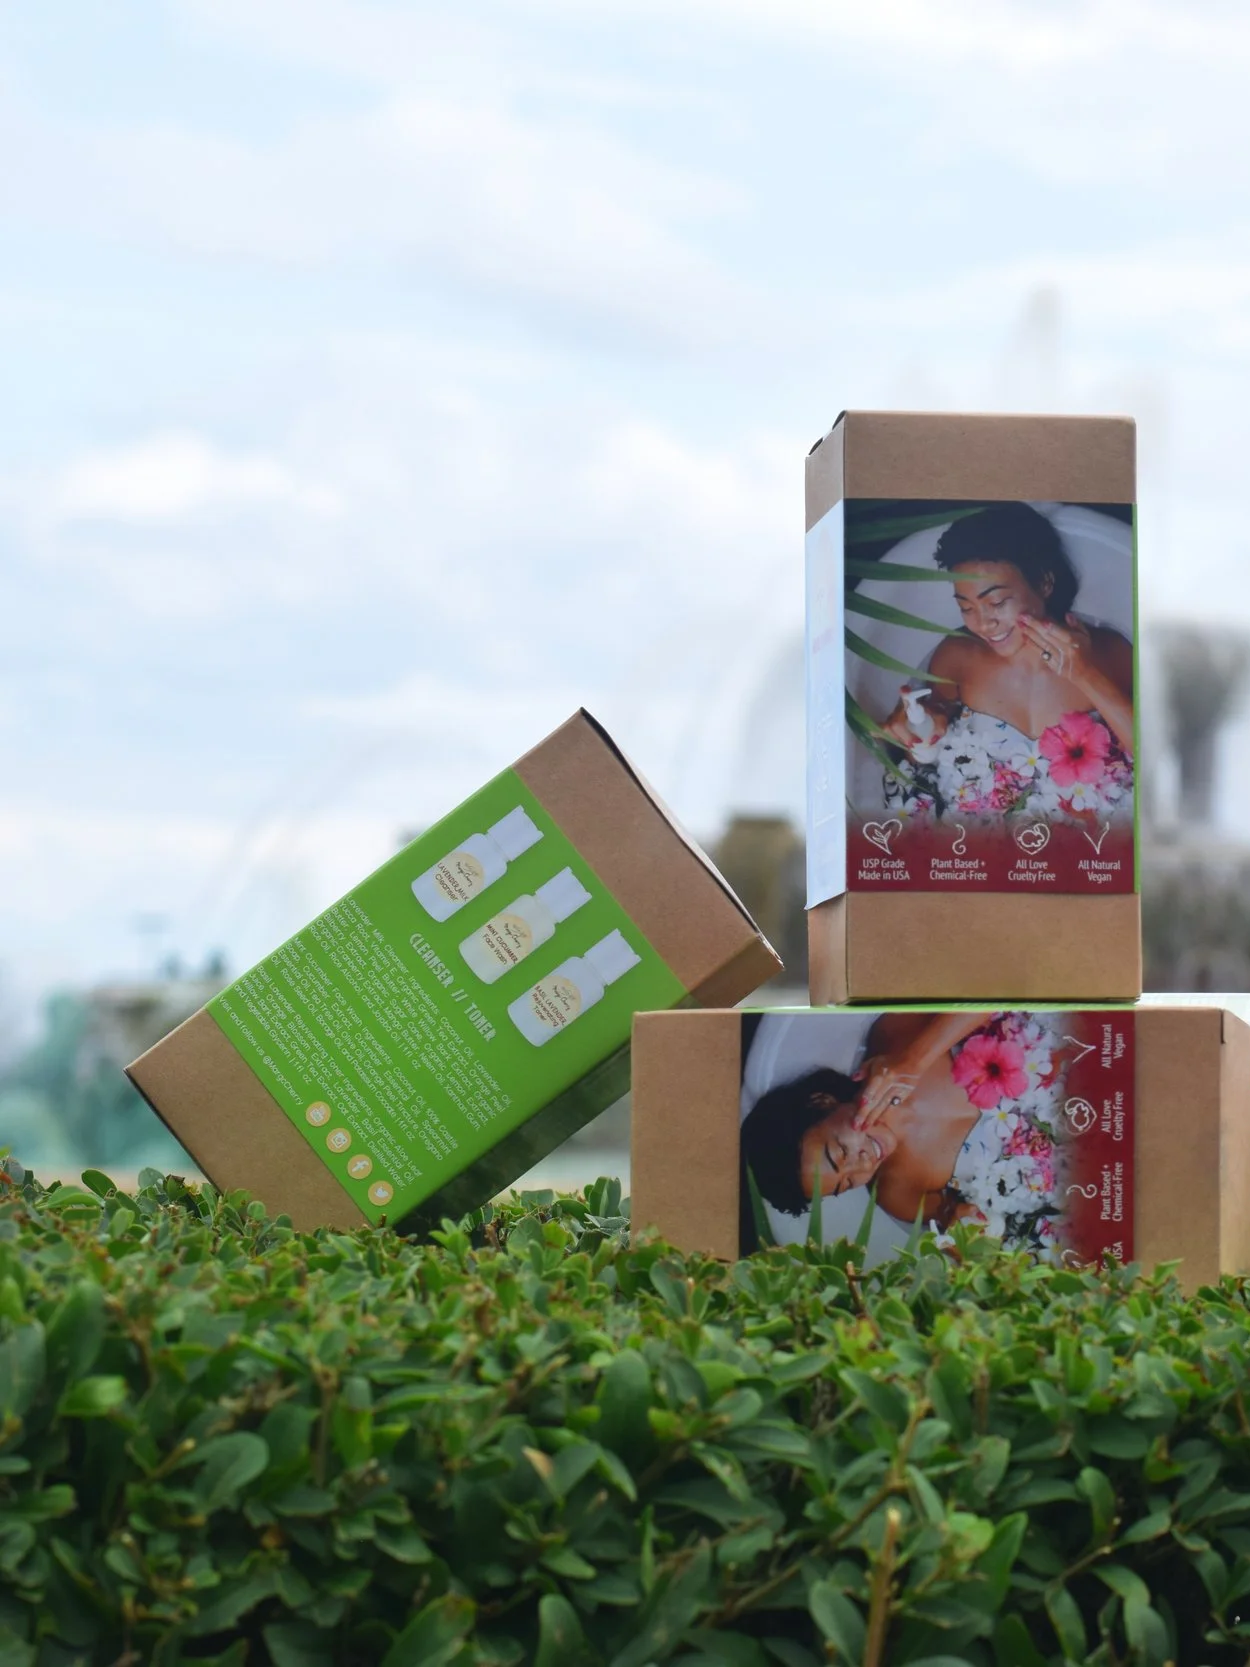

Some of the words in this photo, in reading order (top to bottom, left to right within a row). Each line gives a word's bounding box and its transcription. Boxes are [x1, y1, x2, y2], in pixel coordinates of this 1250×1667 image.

[862, 858, 880, 869] USP
[881, 858, 905, 869] Grade
[931, 858, 952, 869] Plant
[954, 858, 979, 869] Based
[1016, 860, 1027, 869] All
[1029, 860, 1048, 869] Love
[1078, 860, 1090, 870] All
[1091, 860, 1120, 870] Natural
[858, 870, 880, 880] Made
[883, 870, 891, 880] in
[892, 870, 910, 880] USA
[929, 870, 988, 880] Chemical-Free
[1008, 871, 1037, 883] Cruelty
[1038, 871, 1056, 881] Free
[1087, 872, 1112, 883] Vegan
[406, 930, 457, 988] CLEANSER
[462, 1001, 498, 1042] TONER
[1102, 1024, 1112, 1056] Natural
[1114, 1033, 1126, 1059] Vegan
[1102, 1057, 1112, 1069] All
[1113, 1092, 1123, 1111] Free
[1102, 1100, 1111, 1120] Love
[1102, 1122, 1111, 1133] All
[1113, 1112, 1126, 1141] Cruelty
[1101, 1171, 1111, 1195] Based
[1113, 1162, 1123, 1222] Chemical-Free
[1101, 1197, 1111, 1220] Plant
[1113, 1241, 1123, 1259] USA
